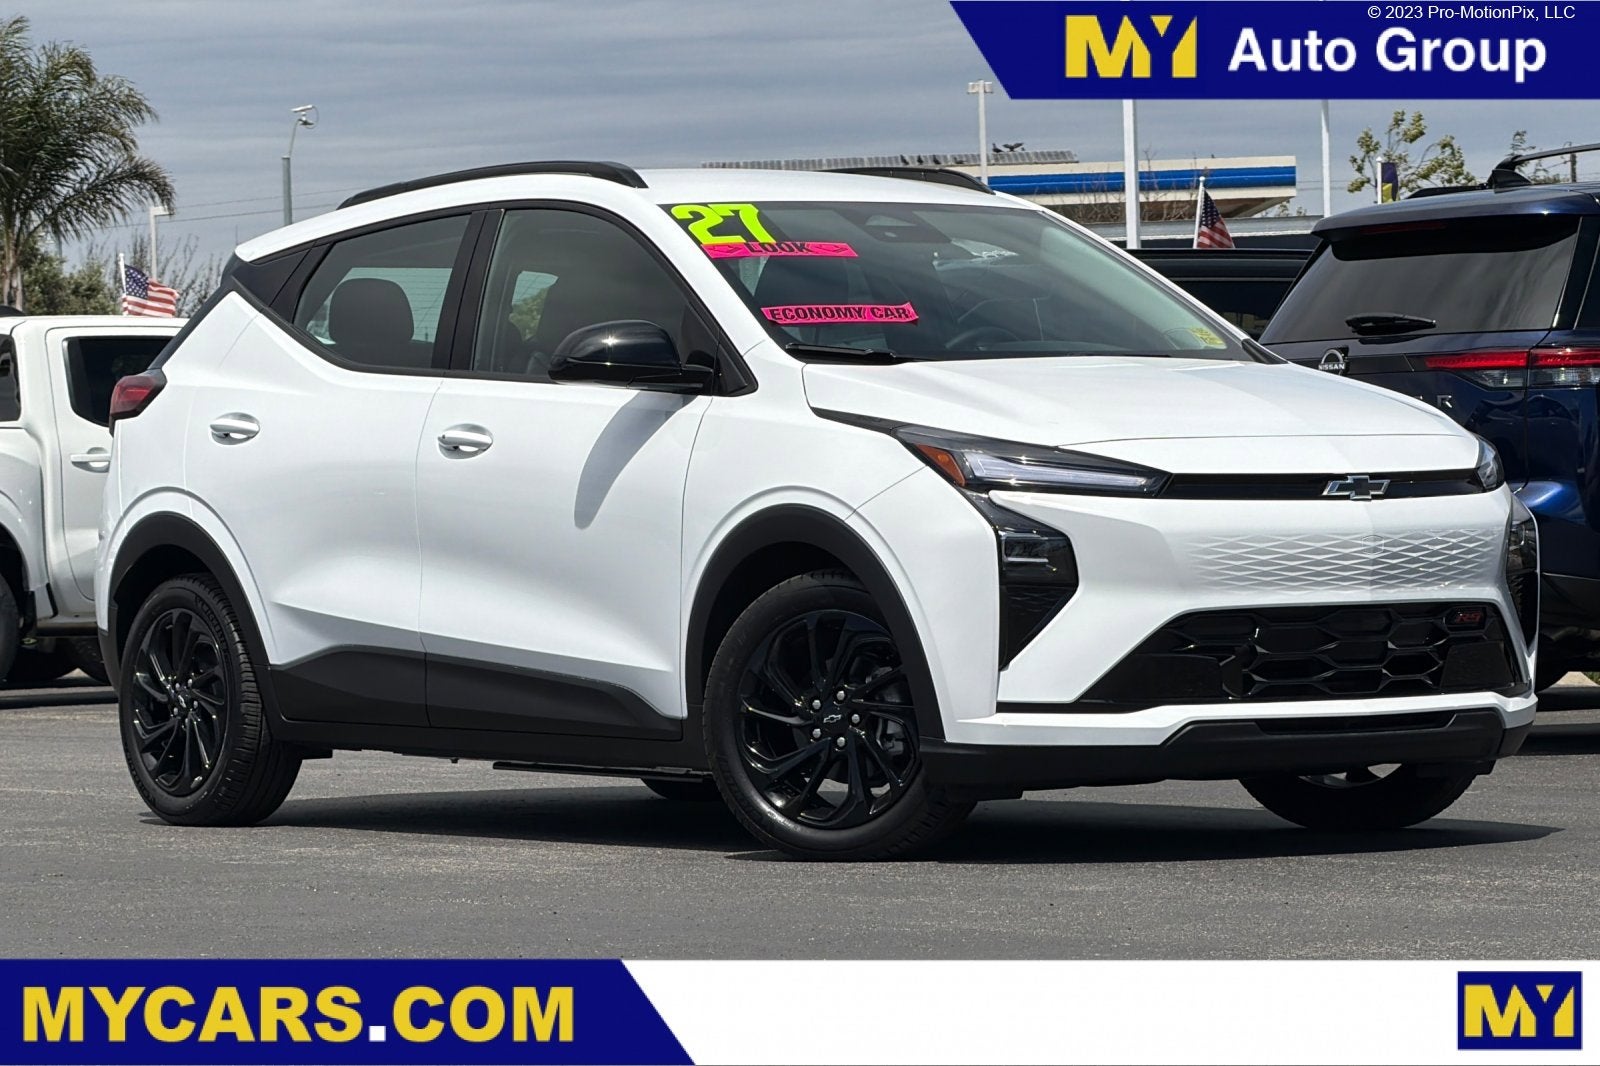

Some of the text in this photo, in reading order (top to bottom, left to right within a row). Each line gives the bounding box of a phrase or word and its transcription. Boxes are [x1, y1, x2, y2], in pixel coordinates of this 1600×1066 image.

[670, 203, 777, 244] 27
[744, 241, 812, 254] LOOK
[769, 306, 909, 321] ECONOMY CAR
